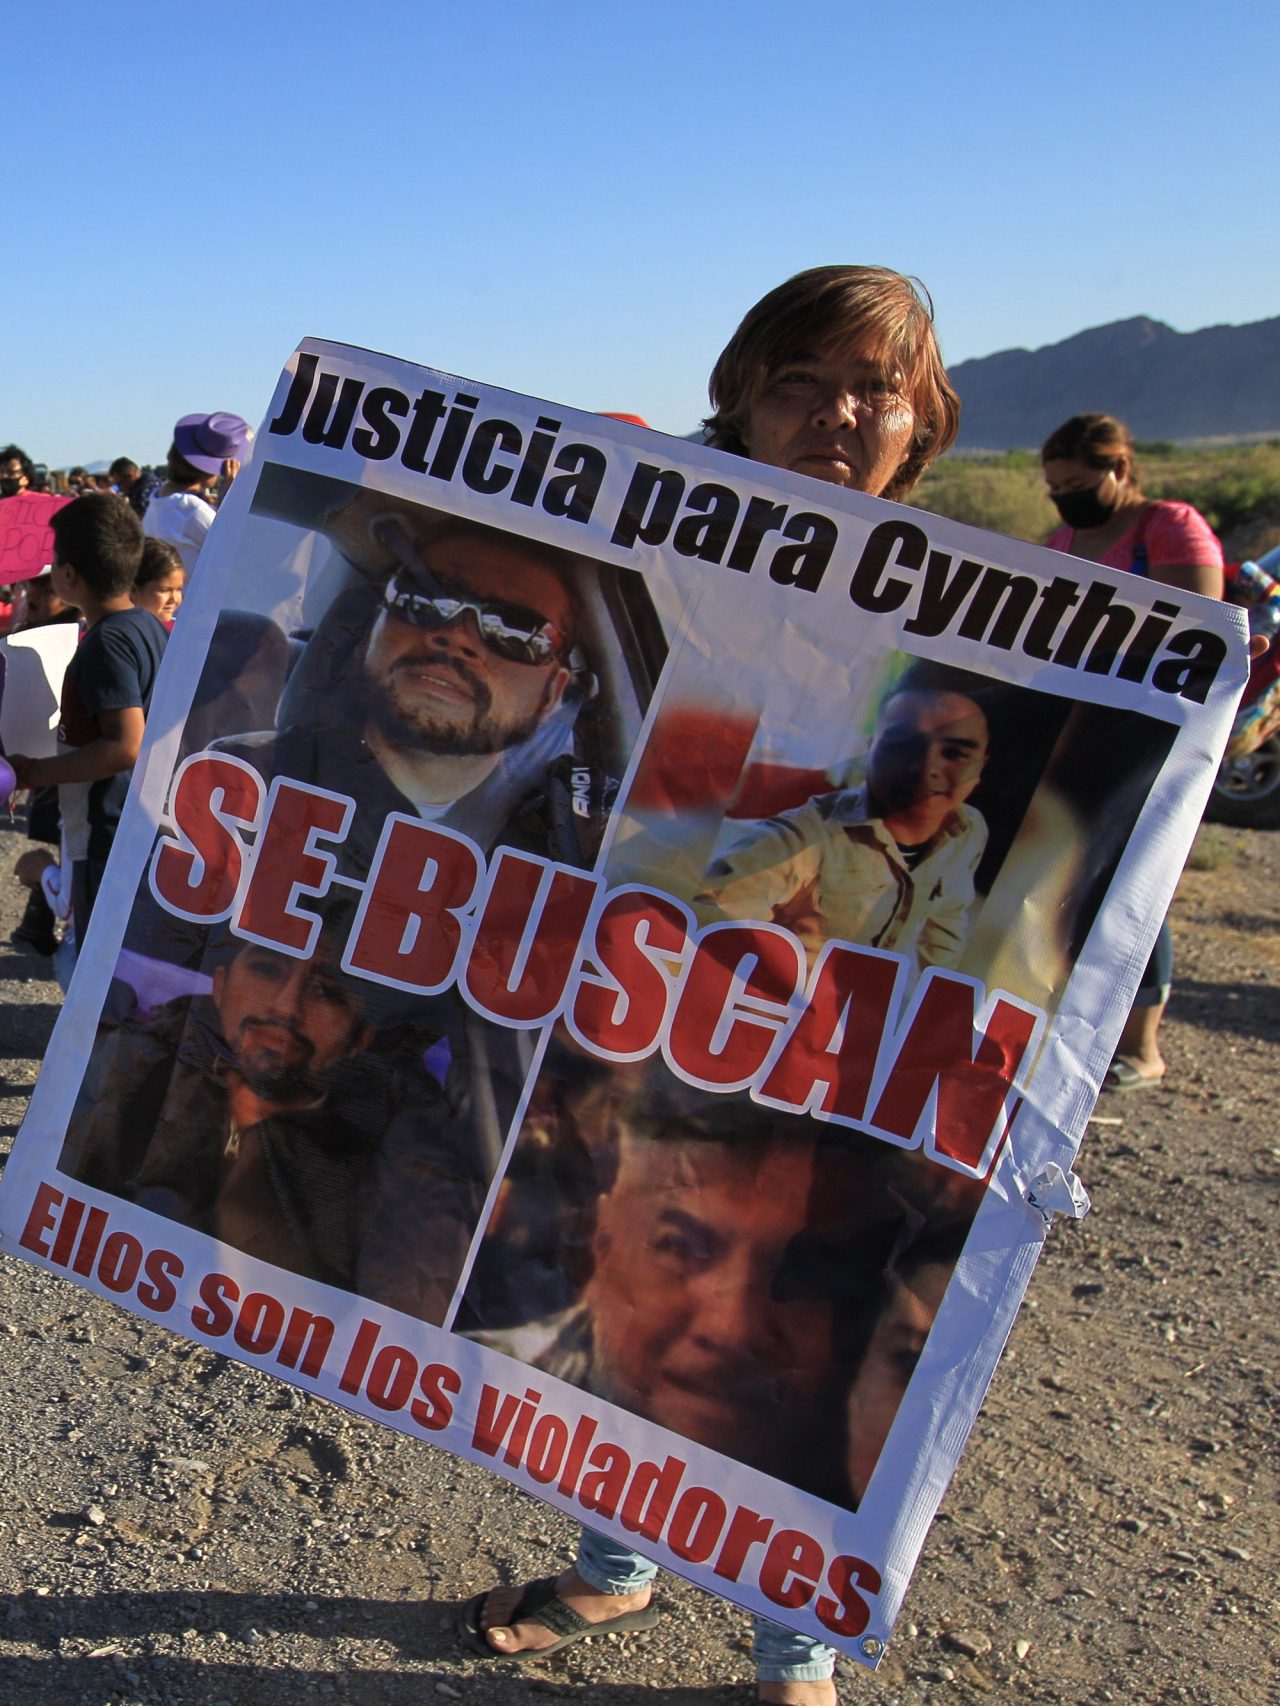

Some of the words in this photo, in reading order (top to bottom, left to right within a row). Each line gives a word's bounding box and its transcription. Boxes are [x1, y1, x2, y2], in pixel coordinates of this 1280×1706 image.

[269, 353, 607, 524] Justicia
[610, 462, 838, 594] para
[849, 520, 1228, 705] Cynthia
[153, 756, 350, 954] SE
[348, 818, 1039, 1170] BUSCAN
[19, 1181, 185, 1313] Ellos
[191, 1273, 335, 1379] son
[338, 1318, 461, 1431] los
[471, 1383, 882, 1638] violadores
